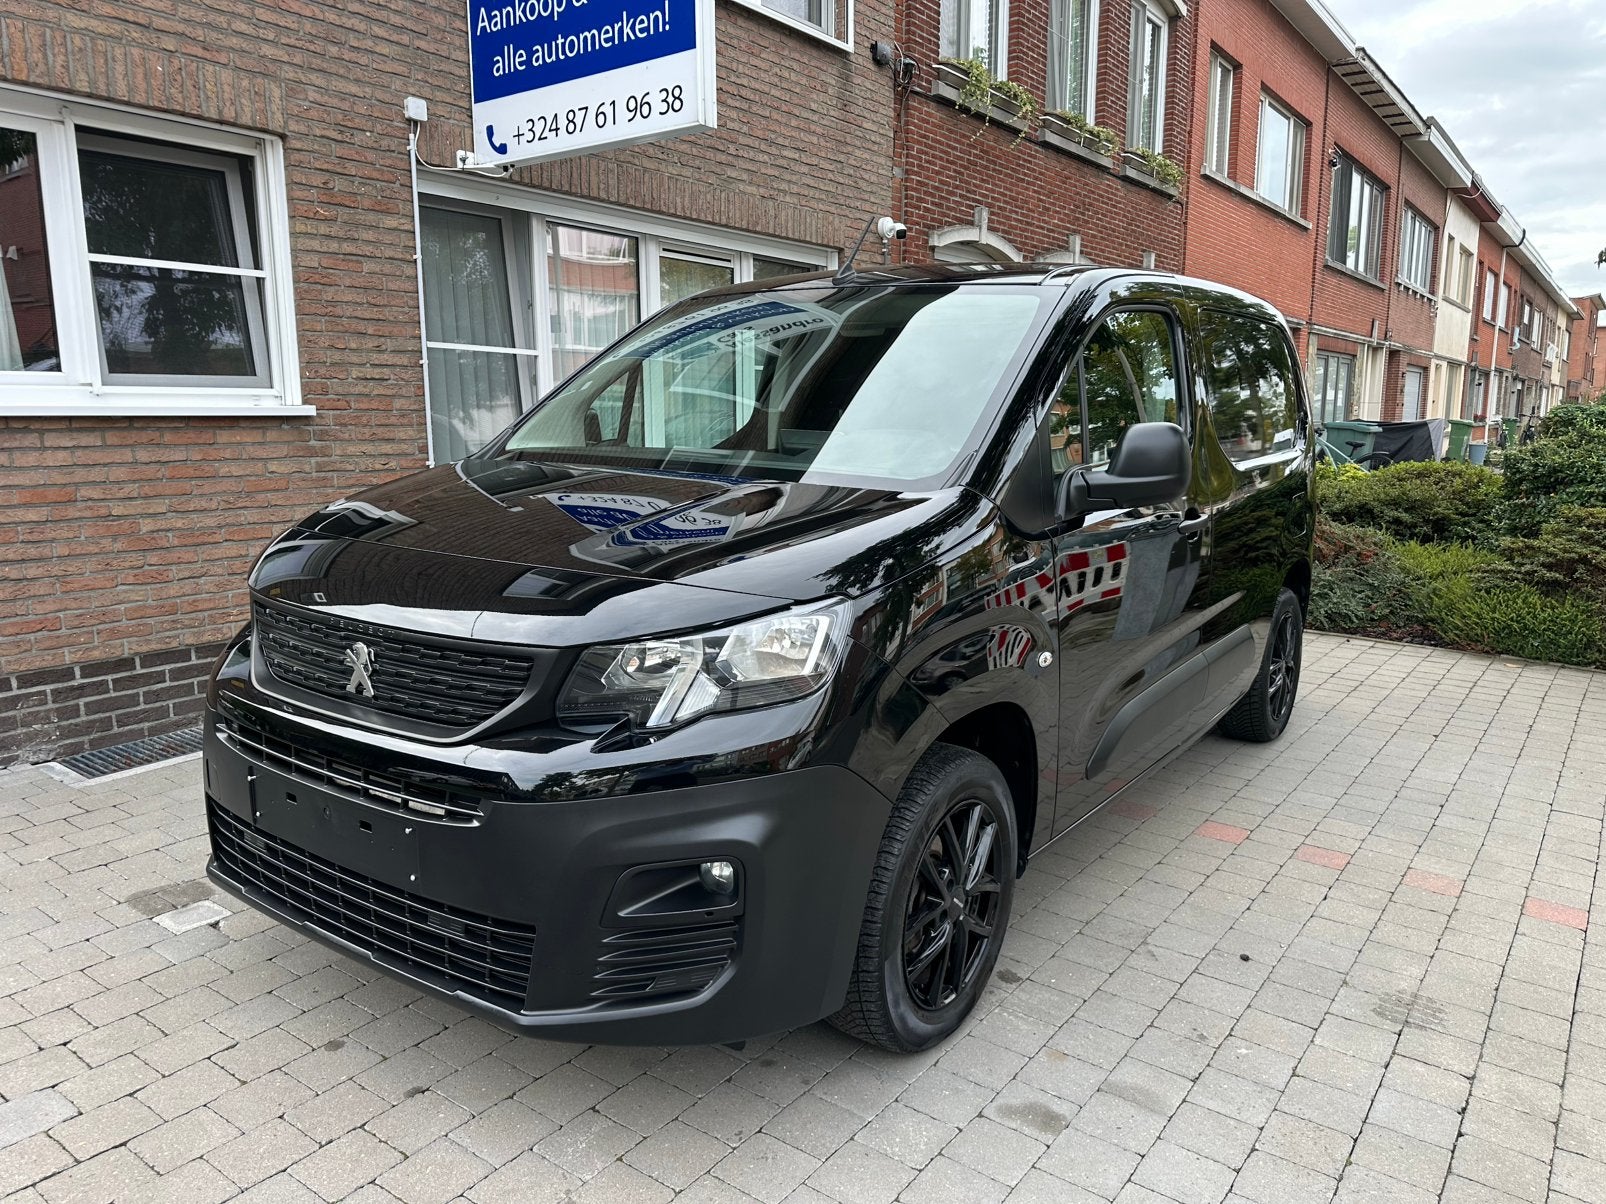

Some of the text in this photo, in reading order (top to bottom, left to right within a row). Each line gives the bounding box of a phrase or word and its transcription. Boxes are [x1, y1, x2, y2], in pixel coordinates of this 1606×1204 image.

[476, 0, 566, 36] Aankoop
[493, 0, 670, 77] alle automerken!
[512, 85, 684, 146] +324 87 61 96 38
[329, 616, 396, 638] PEUGEOT
